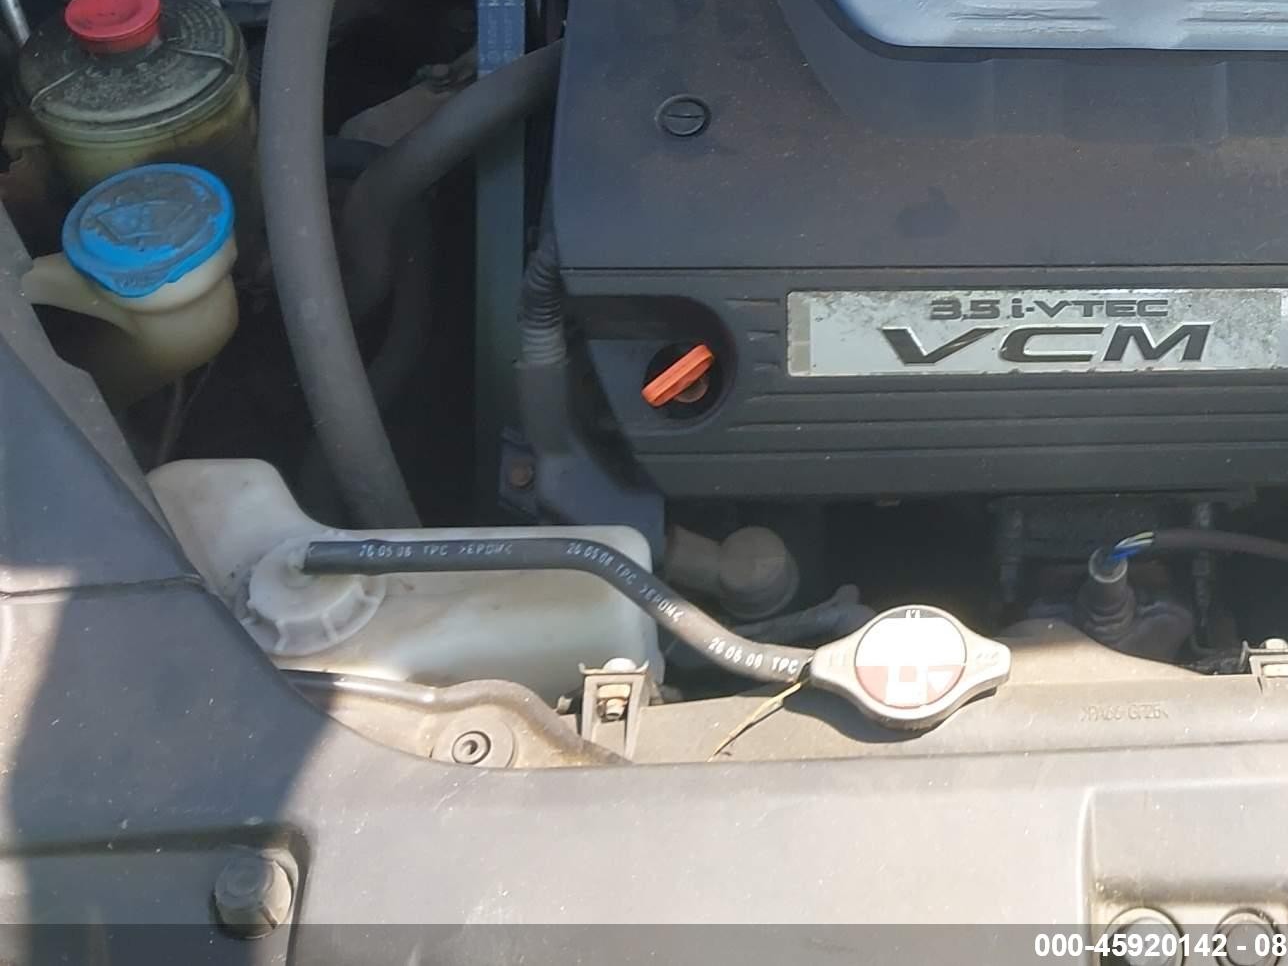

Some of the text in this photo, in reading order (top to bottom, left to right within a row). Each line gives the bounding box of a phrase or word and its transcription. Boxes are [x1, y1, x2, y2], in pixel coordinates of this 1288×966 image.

[1011, 298, 1169, 319] i-VTEC
[880, 323, 1214, 365] VCM
[771, 656, 799, 675] TPC
